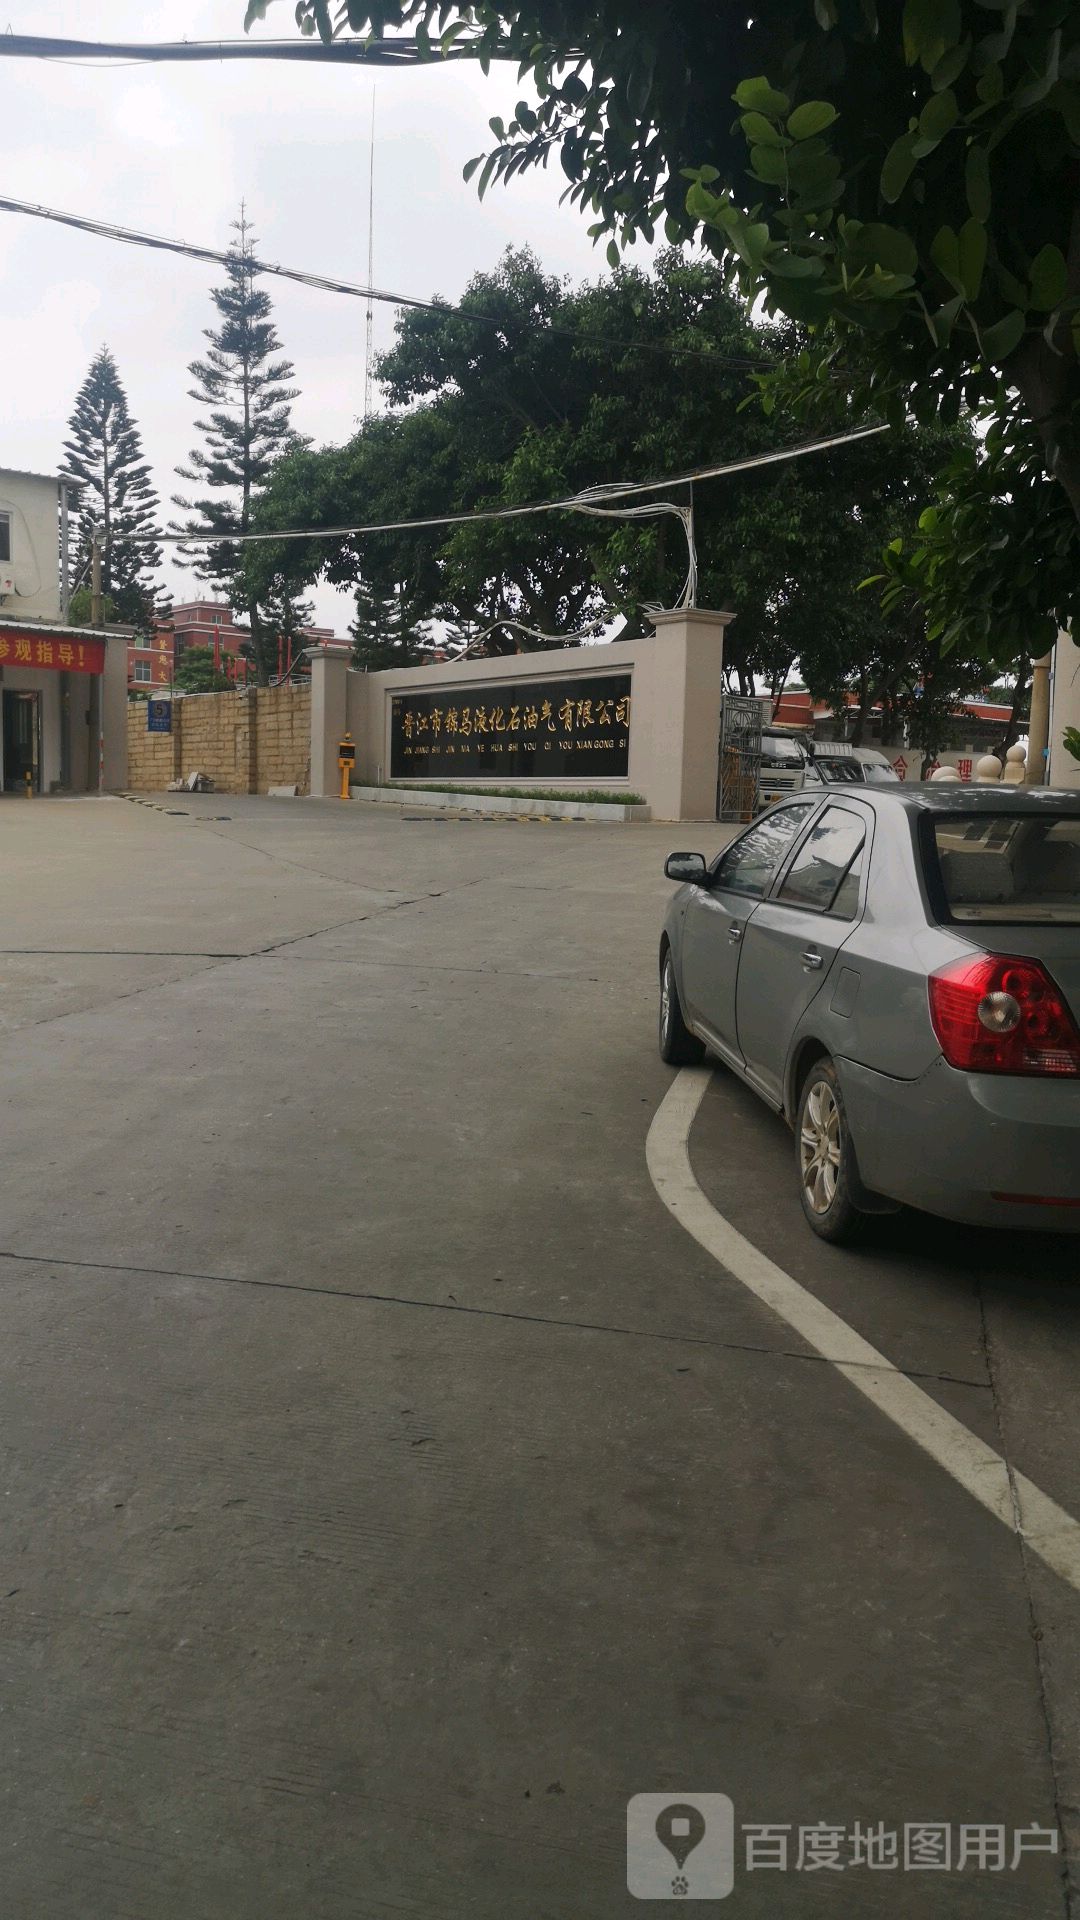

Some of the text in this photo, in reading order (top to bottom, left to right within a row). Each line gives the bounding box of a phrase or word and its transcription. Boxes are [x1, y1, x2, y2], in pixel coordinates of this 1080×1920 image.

[508, 743, 518, 751] SHI
[524, 742, 536, 750] YOU
[559, 741, 573, 749] YOU
[577, 740, 592, 749] XIAN
[594, 739, 614, 748] GONG
[619, 739, 626, 747] SI
